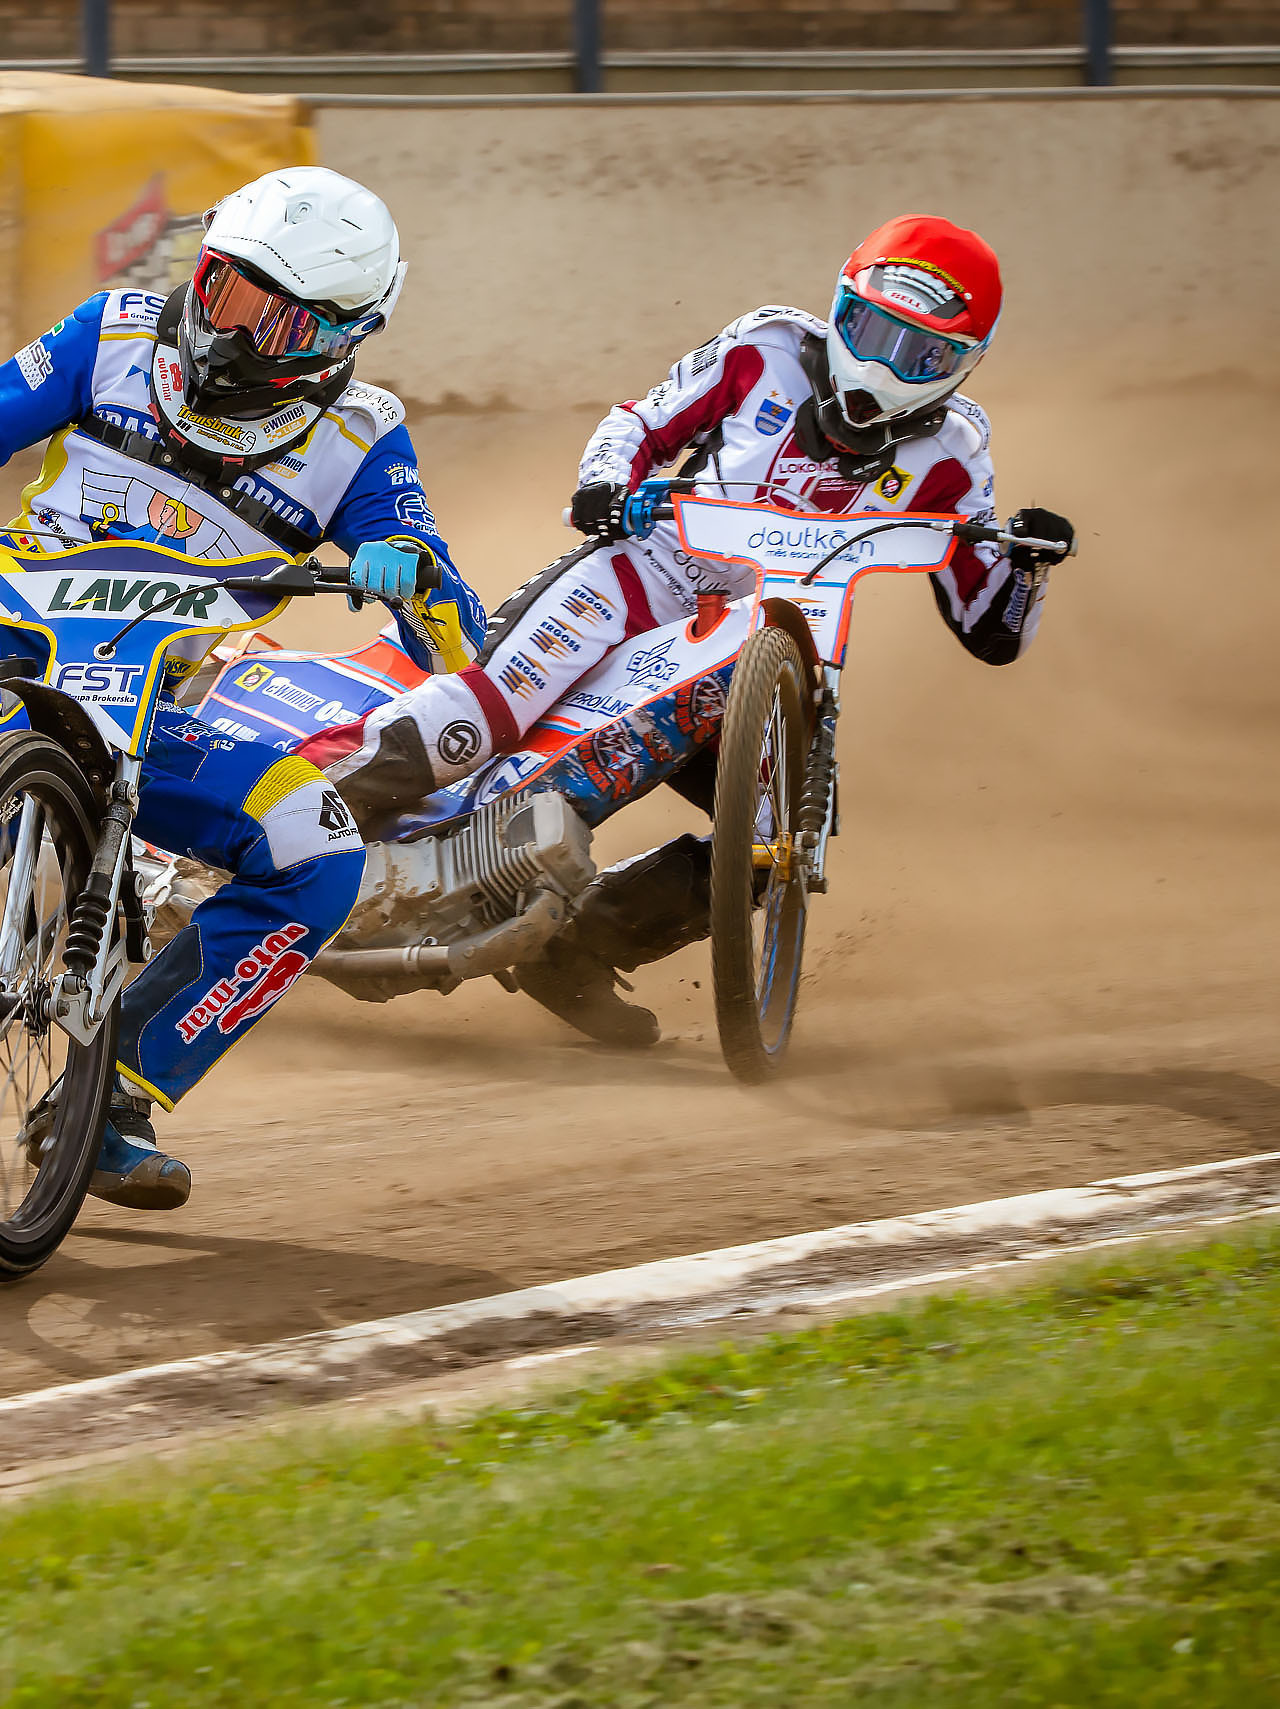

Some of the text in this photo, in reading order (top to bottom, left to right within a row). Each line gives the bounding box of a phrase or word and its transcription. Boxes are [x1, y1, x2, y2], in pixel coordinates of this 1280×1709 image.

[120, 292, 166, 316] FS
[176, 404, 246, 441] Transbruk
[263, 405, 306, 434] eWinner
[47, 577, 219, 620] LAVOR
[572, 589, 613, 621] ERGOSS
[540, 621, 581, 652] ERGOSS
[56, 665, 141, 692] FST
[510, 656, 546, 690] ERGOSS
[92, 694, 135, 703] Brokerska
[328, 829, 351, 842] AUTO
[176, 924, 308, 1043] auto-mar
